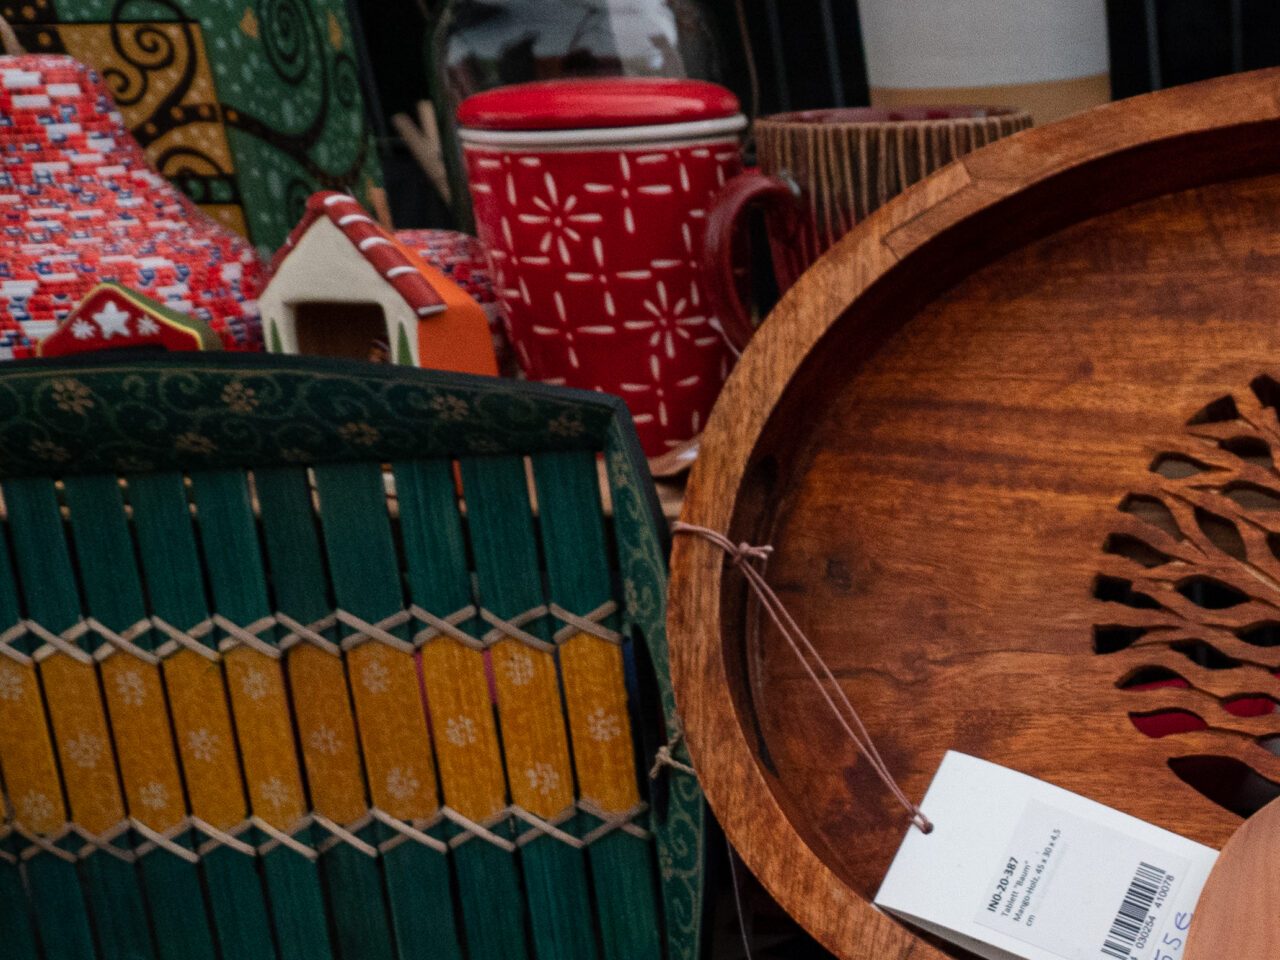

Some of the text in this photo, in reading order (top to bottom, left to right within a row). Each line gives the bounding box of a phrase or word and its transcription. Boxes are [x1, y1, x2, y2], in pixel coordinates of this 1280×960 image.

[1035, 864, 1045, 875] 45
[1000, 890, 1020, 917] Tablett
[1135, 915, 1156, 949] 030254
[1154, 874, 1175, 908] 410078
[1026, 914, 1036, 927] cm
